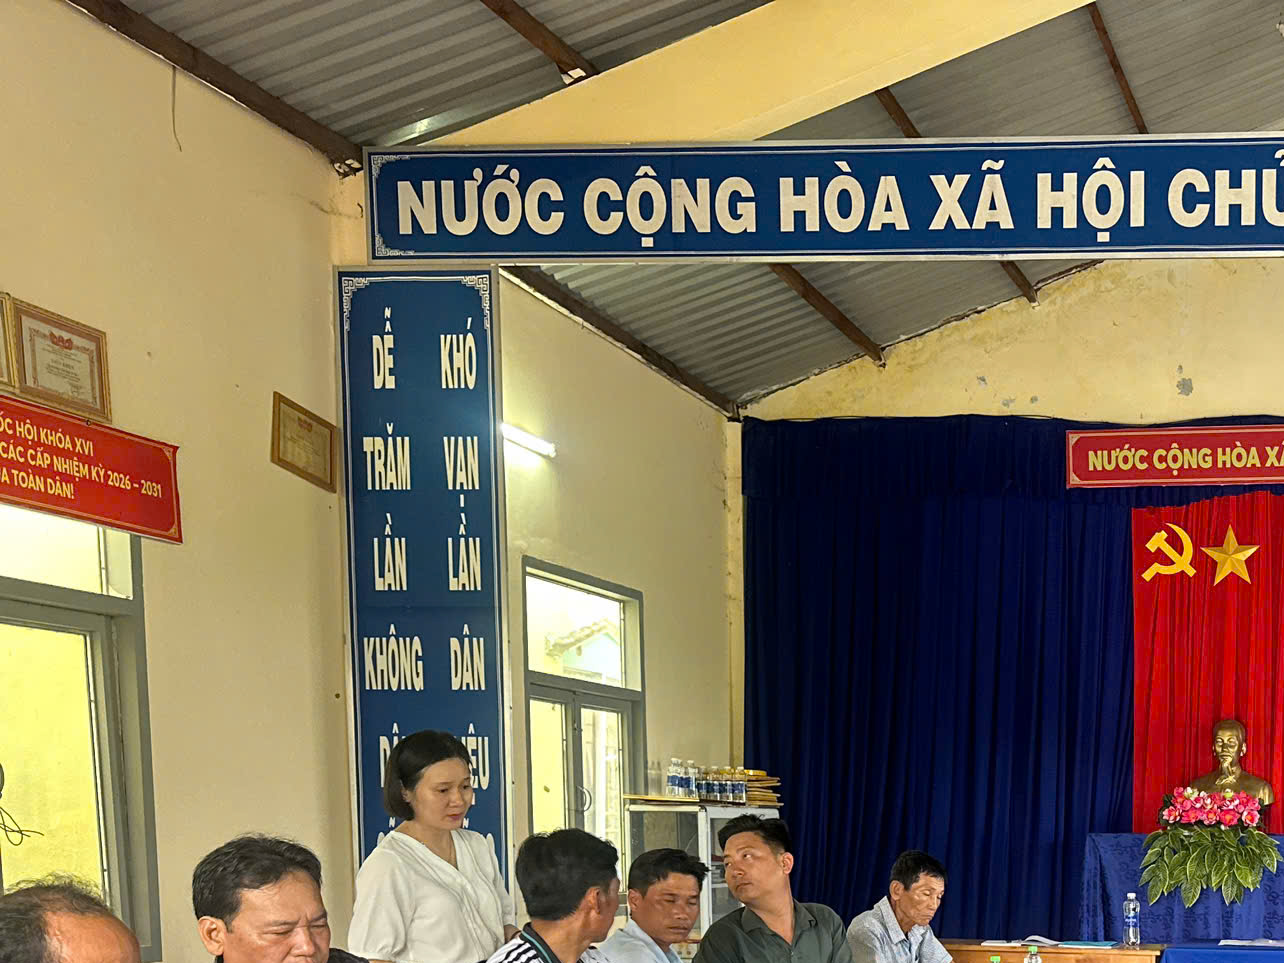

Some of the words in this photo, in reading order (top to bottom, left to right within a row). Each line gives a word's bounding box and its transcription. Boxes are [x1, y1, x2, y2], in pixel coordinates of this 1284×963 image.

[399, 163, 565, 236] NƯỚC
[583, 165, 756, 248] CỘNG
[779, 161, 910, 233] HÒA
[929, 158, 1014, 231] XÃ
[1036, 156, 1144, 243] HỘI
[371, 307, 396, 389] DỄ
[440, 317, 477, 390] KHÓ
[0, 440, 25, 463] CÁC
[27, 447, 51, 468] CẤP
[53, 456, 89, 482] NHIỆM
[91, 463, 105, 483] KỲ
[107, 470, 131, 490] 2026
[141, 480, 162, 498] 2031
[16, 419, 38, 445] HỘI
[40, 428, 73, 451] KHÓA
[74, 437, 94, 457] XVI
[362, 422, 411, 490] TRĂM
[443, 436, 480, 508] VẠN
[1087, 443, 1149, 471] NƯỚC
[1153, 443, 1213, 476] CỘNG
[1217, 441, 1261, 468] HÒA
[11, 468, 45, 492] TOÀN
[47, 476, 74, 499] DÂN!
[373, 512, 408, 591] LẦN
[447, 512, 482, 591] LẦN
[363, 623, 424, 692] KHÔNG
[450, 623, 486, 691] DÂN
